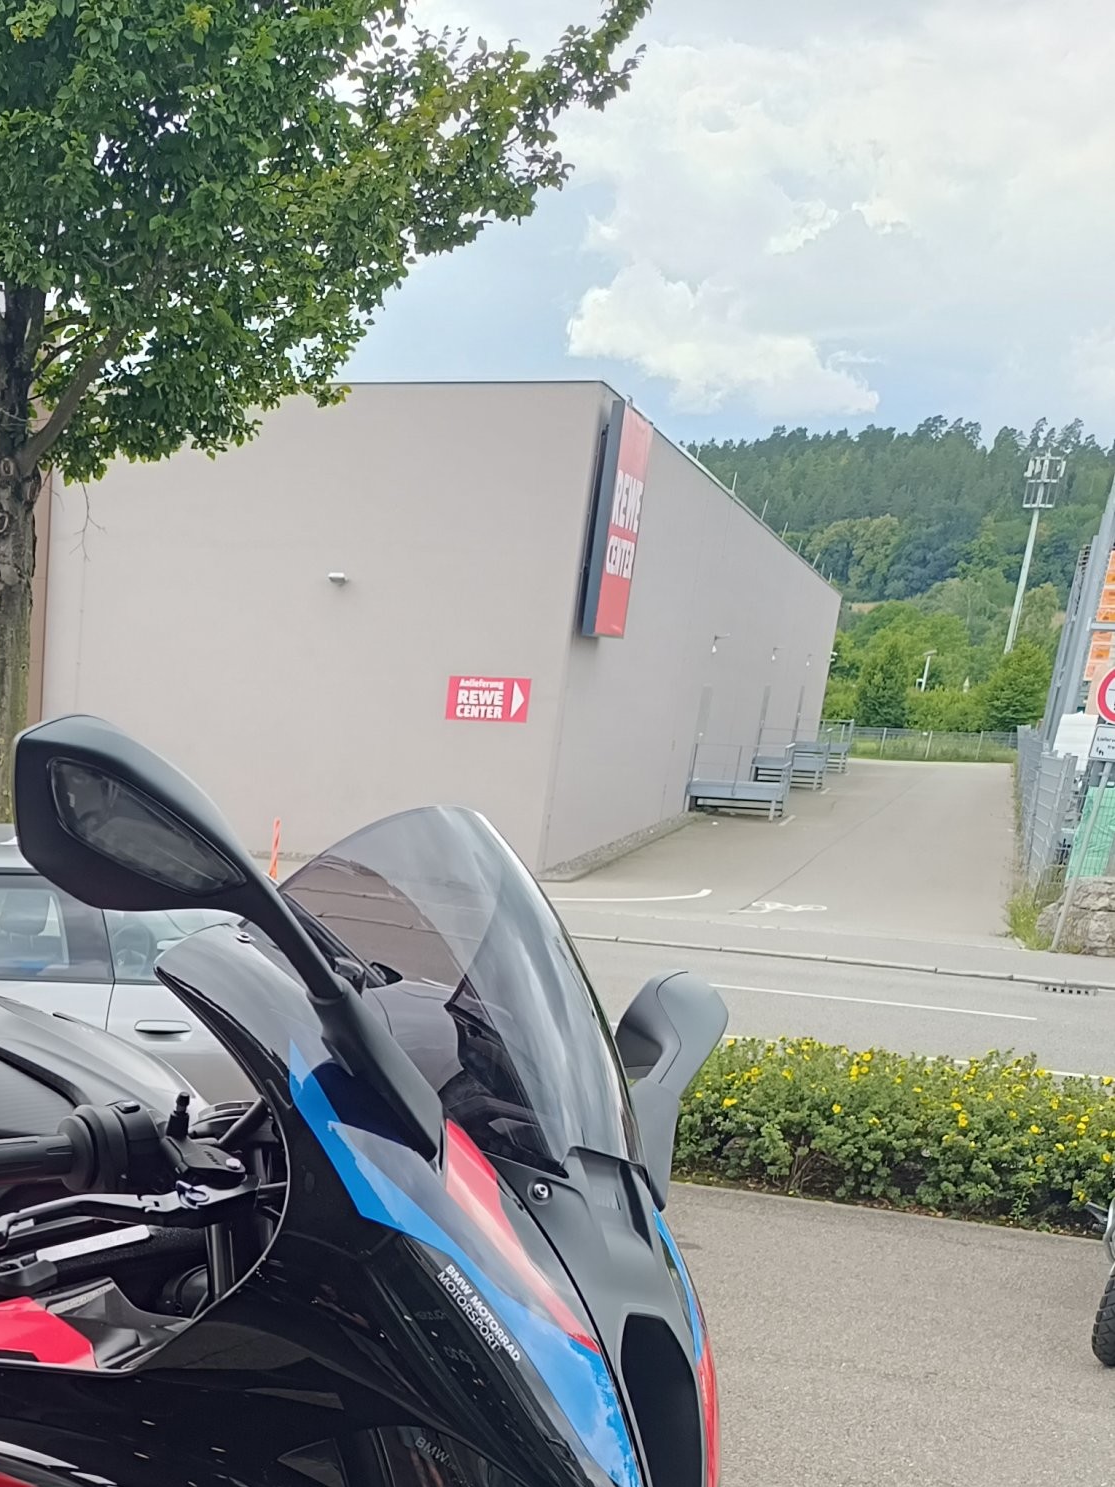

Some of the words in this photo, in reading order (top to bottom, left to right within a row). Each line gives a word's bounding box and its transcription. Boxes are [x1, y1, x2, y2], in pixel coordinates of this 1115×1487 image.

[610, 470, 645, 533] REWE
[605, 535, 636, 579] CENTER
[455, 705, 502, 719] CENTER
[457, 689, 504, 706] REWE
[436, 1271, 500, 1351] MOTORSPORT
[444, 1263, 472, 1295] BMW
[469, 1294, 521, 1362] MOTORRAD
[415, 1436, 449, 1463] BMW
